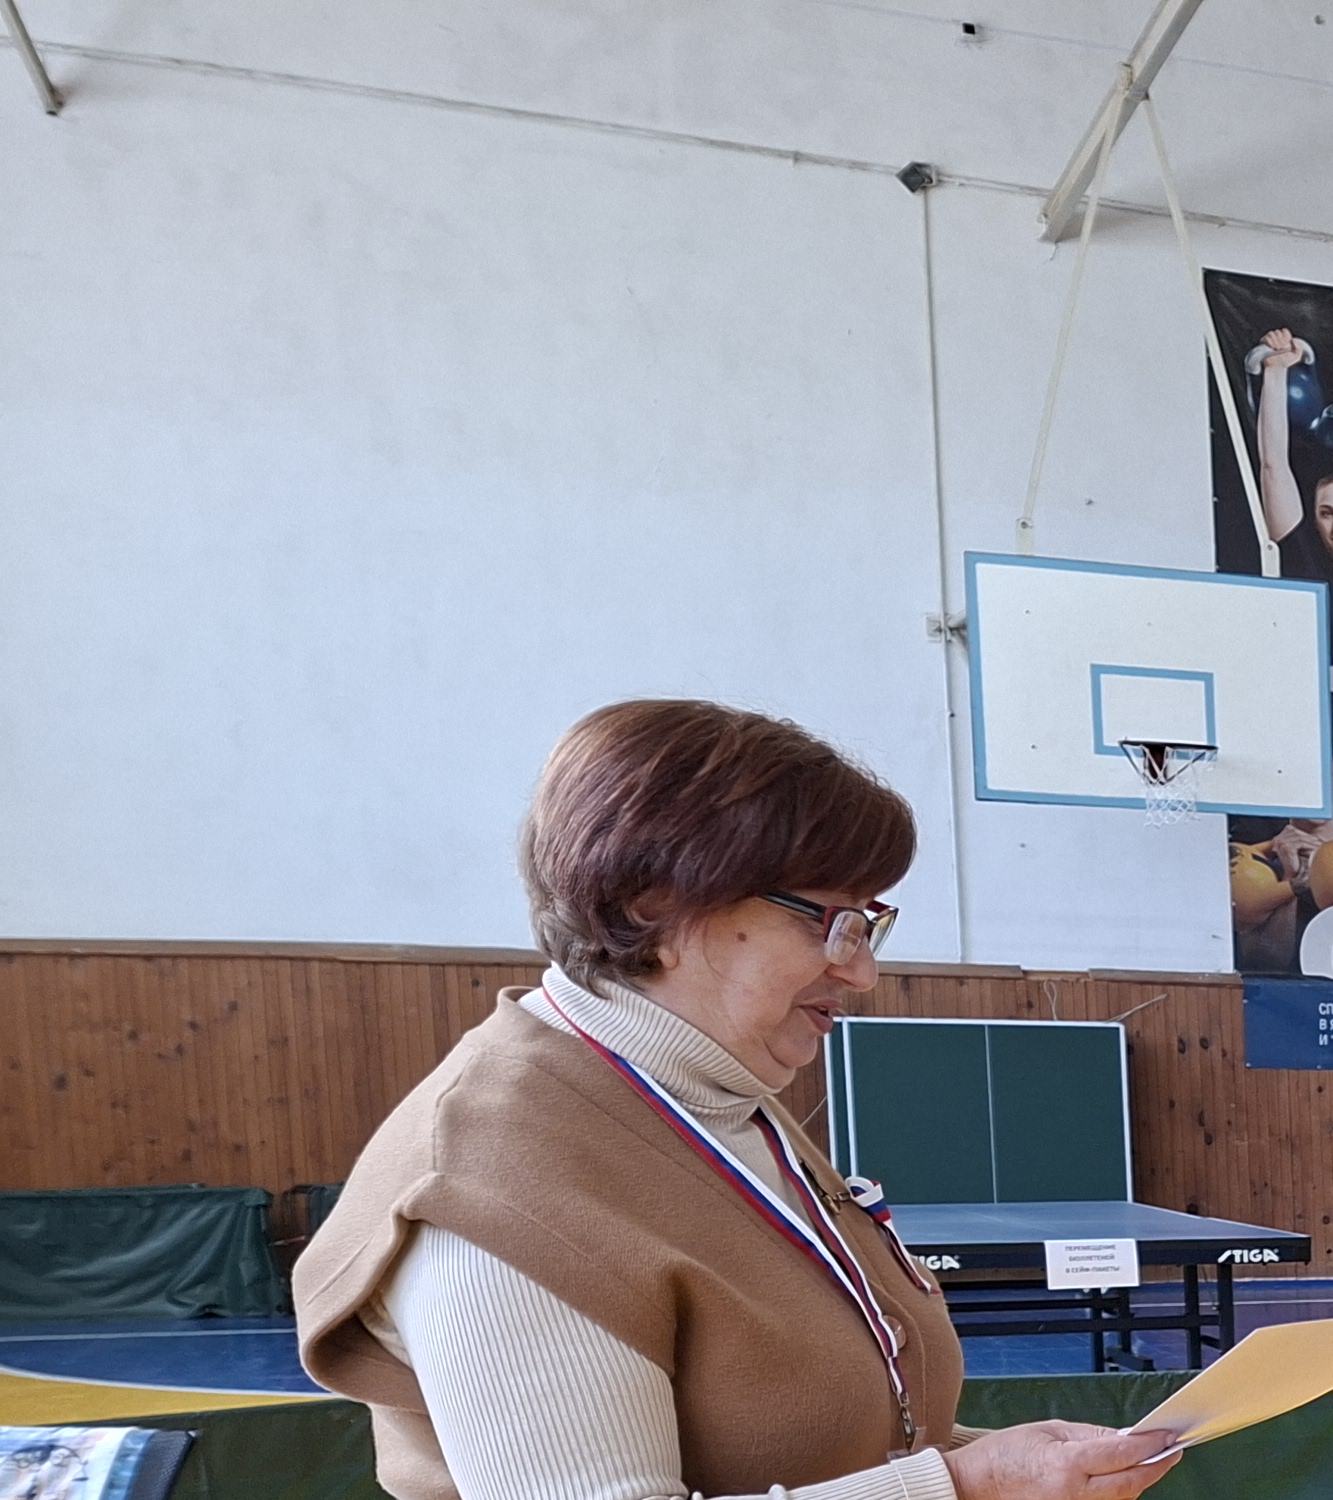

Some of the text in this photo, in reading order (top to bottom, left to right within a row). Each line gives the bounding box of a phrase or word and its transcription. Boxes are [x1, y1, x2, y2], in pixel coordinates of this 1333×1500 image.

[1319, 1019, 1327, 1030] В
[1319, 1034, 1328, 1045] И
[1217, 1248, 1279, 1263] STIGA
[910, 1255, 960, 1270] IGA
